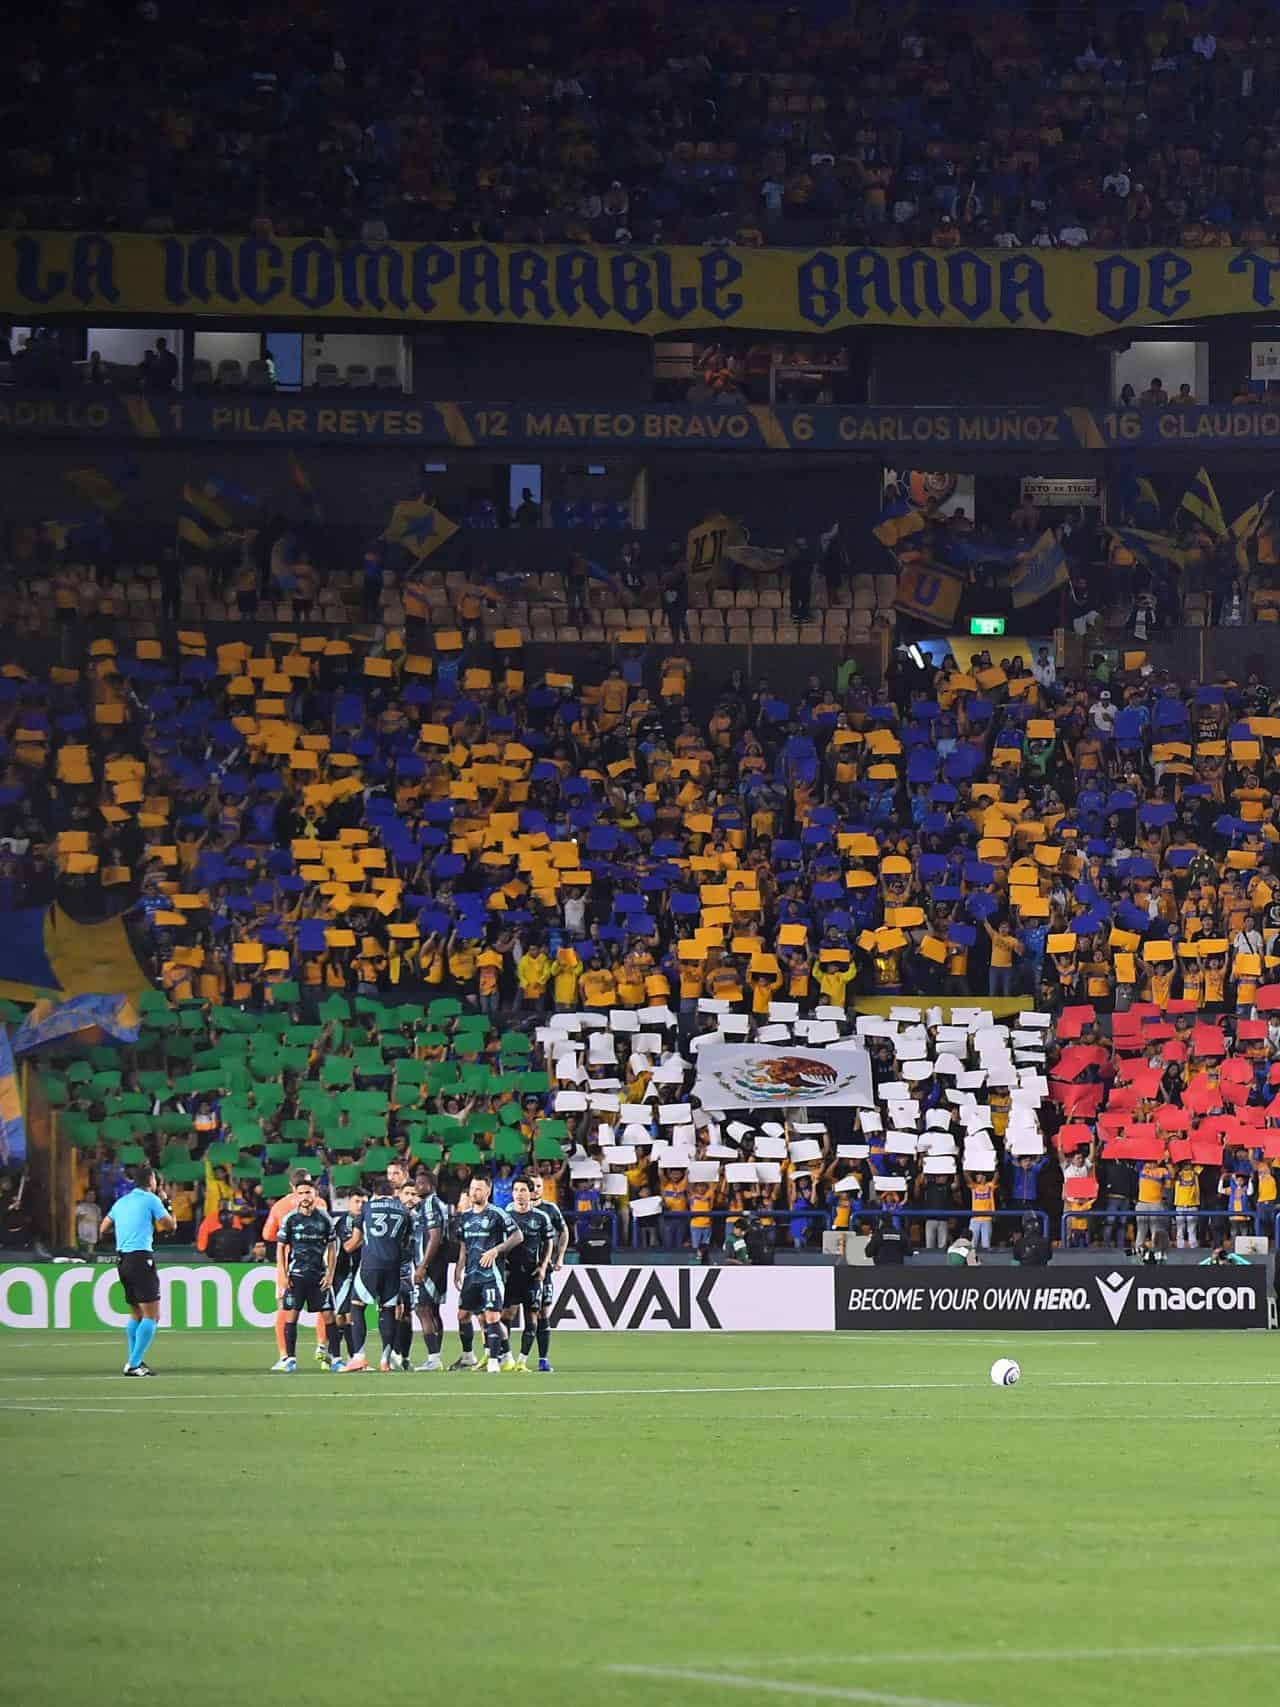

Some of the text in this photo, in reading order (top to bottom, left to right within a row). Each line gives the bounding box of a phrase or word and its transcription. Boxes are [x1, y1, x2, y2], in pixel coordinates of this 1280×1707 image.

[212, 406, 306, 435] PILAR
[318, 407, 425, 436] REYES
[474, 410, 752, 440] 12 MATEO BRAVO
[792, 408, 1060, 442] 6 CARLOS MUÑOZ
[1104, 412, 1142, 441] 16
[1158, 412, 1278, 439] CLAUDIO
[370, 1212, 404, 1238] 37
[515, 1267, 723, 1329] AVAK
[848, 1288, 1091, 1311] BECOME YOUR OWN HERO.
[1137, 1286, 1257, 1311] macron
